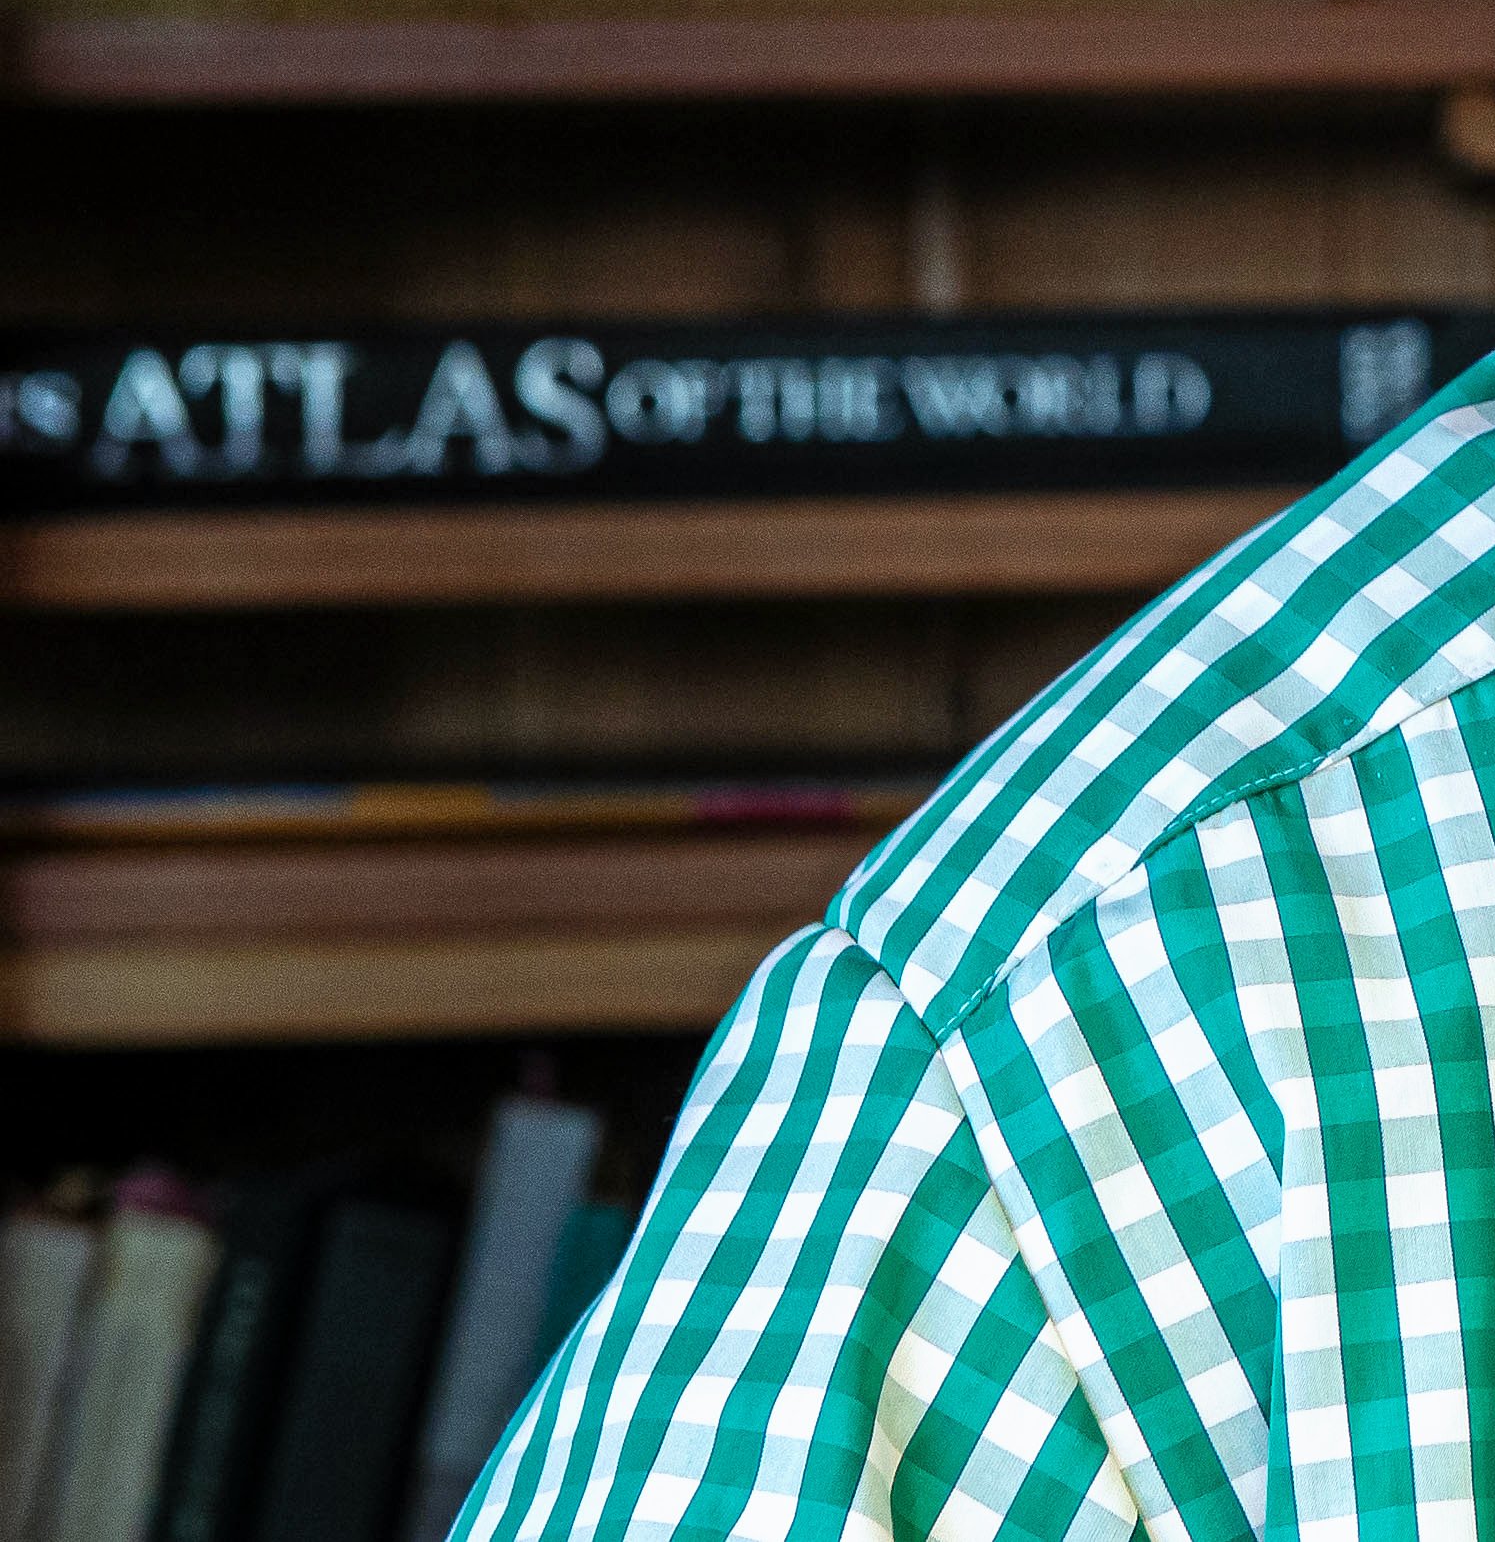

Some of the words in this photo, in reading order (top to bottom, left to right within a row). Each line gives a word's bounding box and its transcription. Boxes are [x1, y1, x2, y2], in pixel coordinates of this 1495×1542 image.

[96, 338, 606, 478] ATLAS
[606, 357, 727, 443] OF
[723, 357, 904, 443] THE
[898, 354, 1212, 440] WORLD
